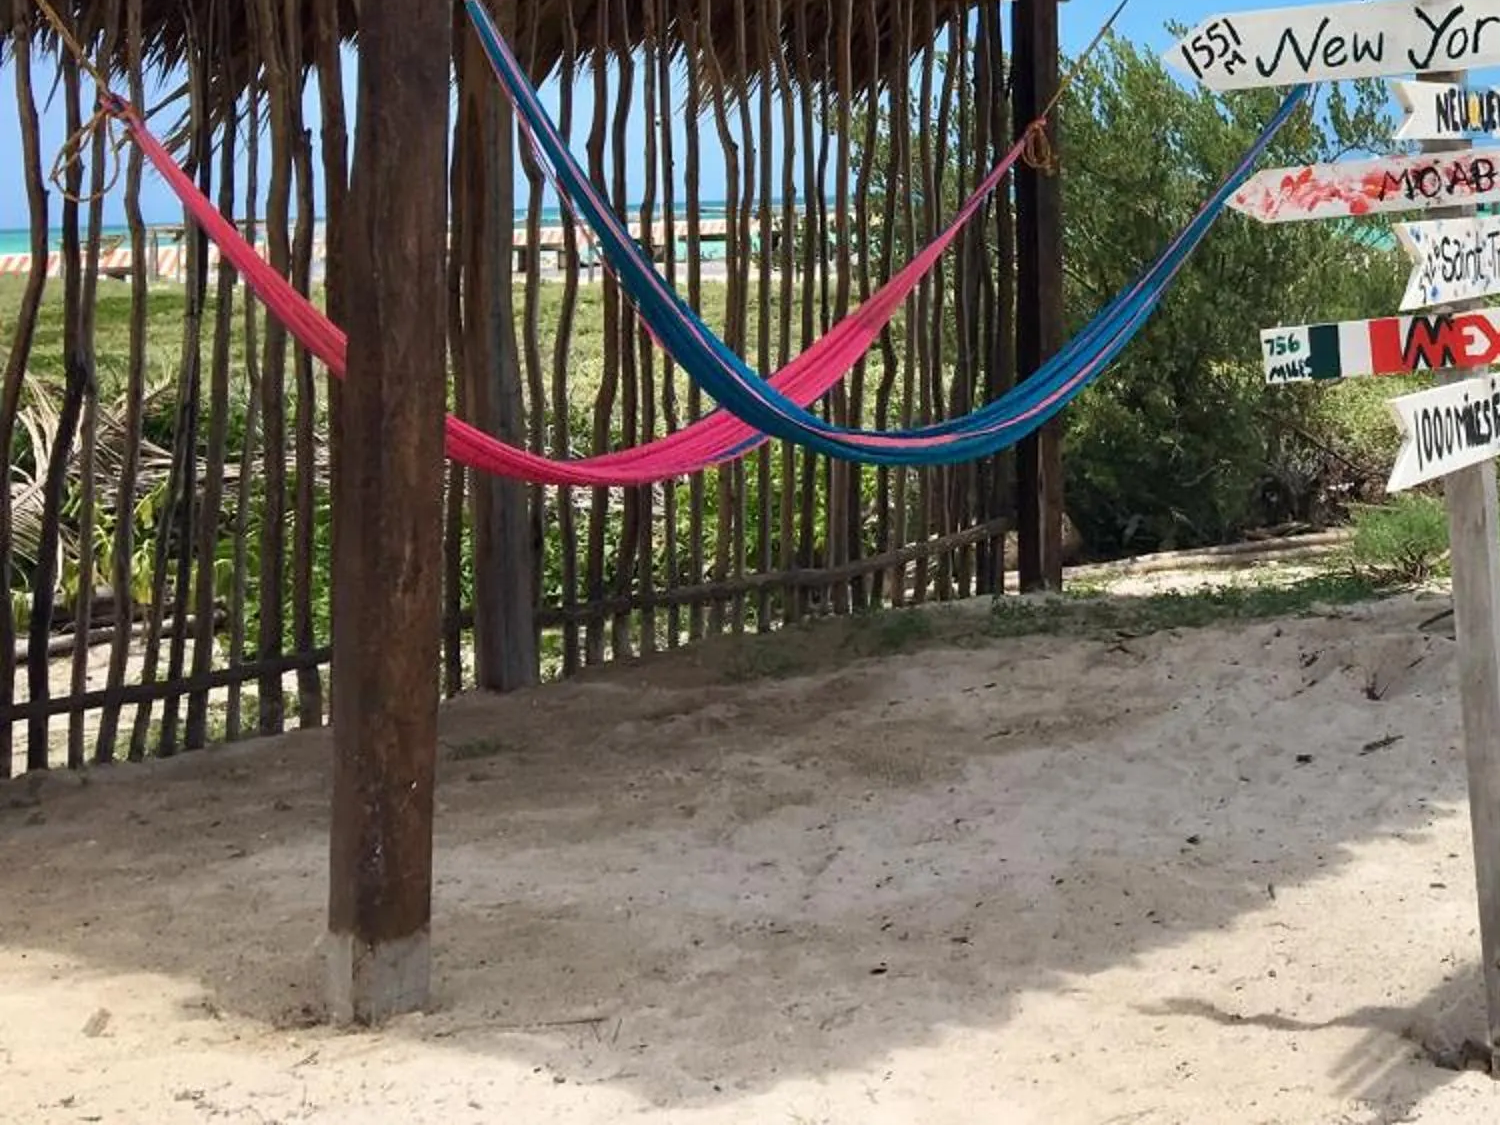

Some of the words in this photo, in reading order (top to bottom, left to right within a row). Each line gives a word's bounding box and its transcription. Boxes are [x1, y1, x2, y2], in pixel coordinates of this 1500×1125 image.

[1181, 17, 1242, 79] 1551
[1255, 17, 1384, 78] New
[1377, 158, 1497, 202] MOAB
[1441, 232, 1485, 283] Saint
[1264, 333, 1300, 356] 756
[1414, 406, 1454, 472] 1000
